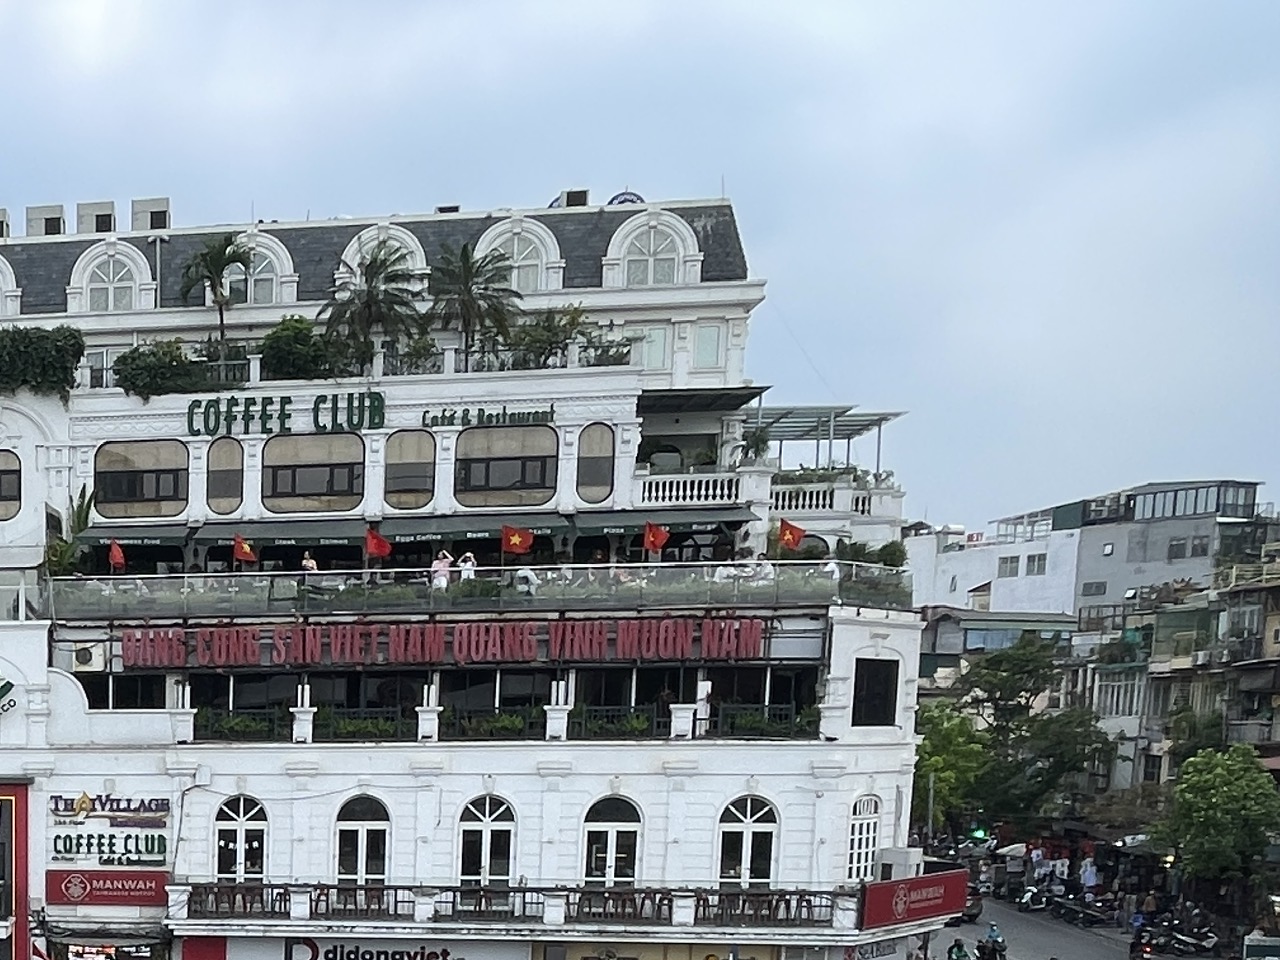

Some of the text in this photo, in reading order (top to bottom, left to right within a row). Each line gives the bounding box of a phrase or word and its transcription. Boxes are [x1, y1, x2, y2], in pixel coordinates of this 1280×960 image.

[187, 391, 386, 435] COFFEE CLUB
[389, 624, 445, 663] NAM
[453, 621, 538, 665] QUANG
[549, 618, 608, 660] VINH
[53, 833, 167, 855] COFFEE CLUB
[92, 879, 157, 890] MANWAH
